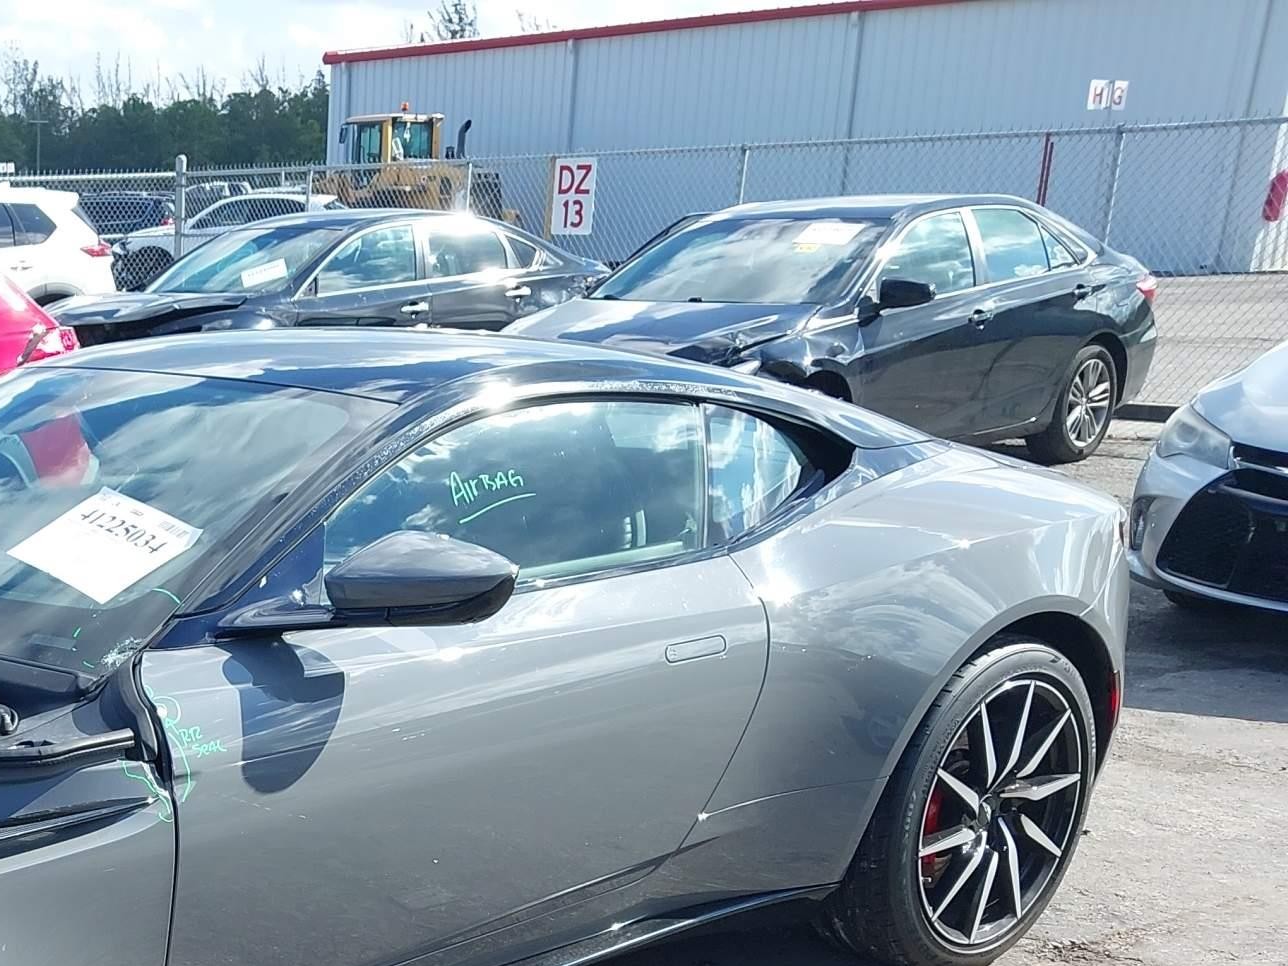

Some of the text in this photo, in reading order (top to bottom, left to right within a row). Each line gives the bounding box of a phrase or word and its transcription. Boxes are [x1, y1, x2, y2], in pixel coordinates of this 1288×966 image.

[558, 164, 592, 195] DZ
[562, 199, 583, 229] 13
[79, 508, 168, 554] 41225034
